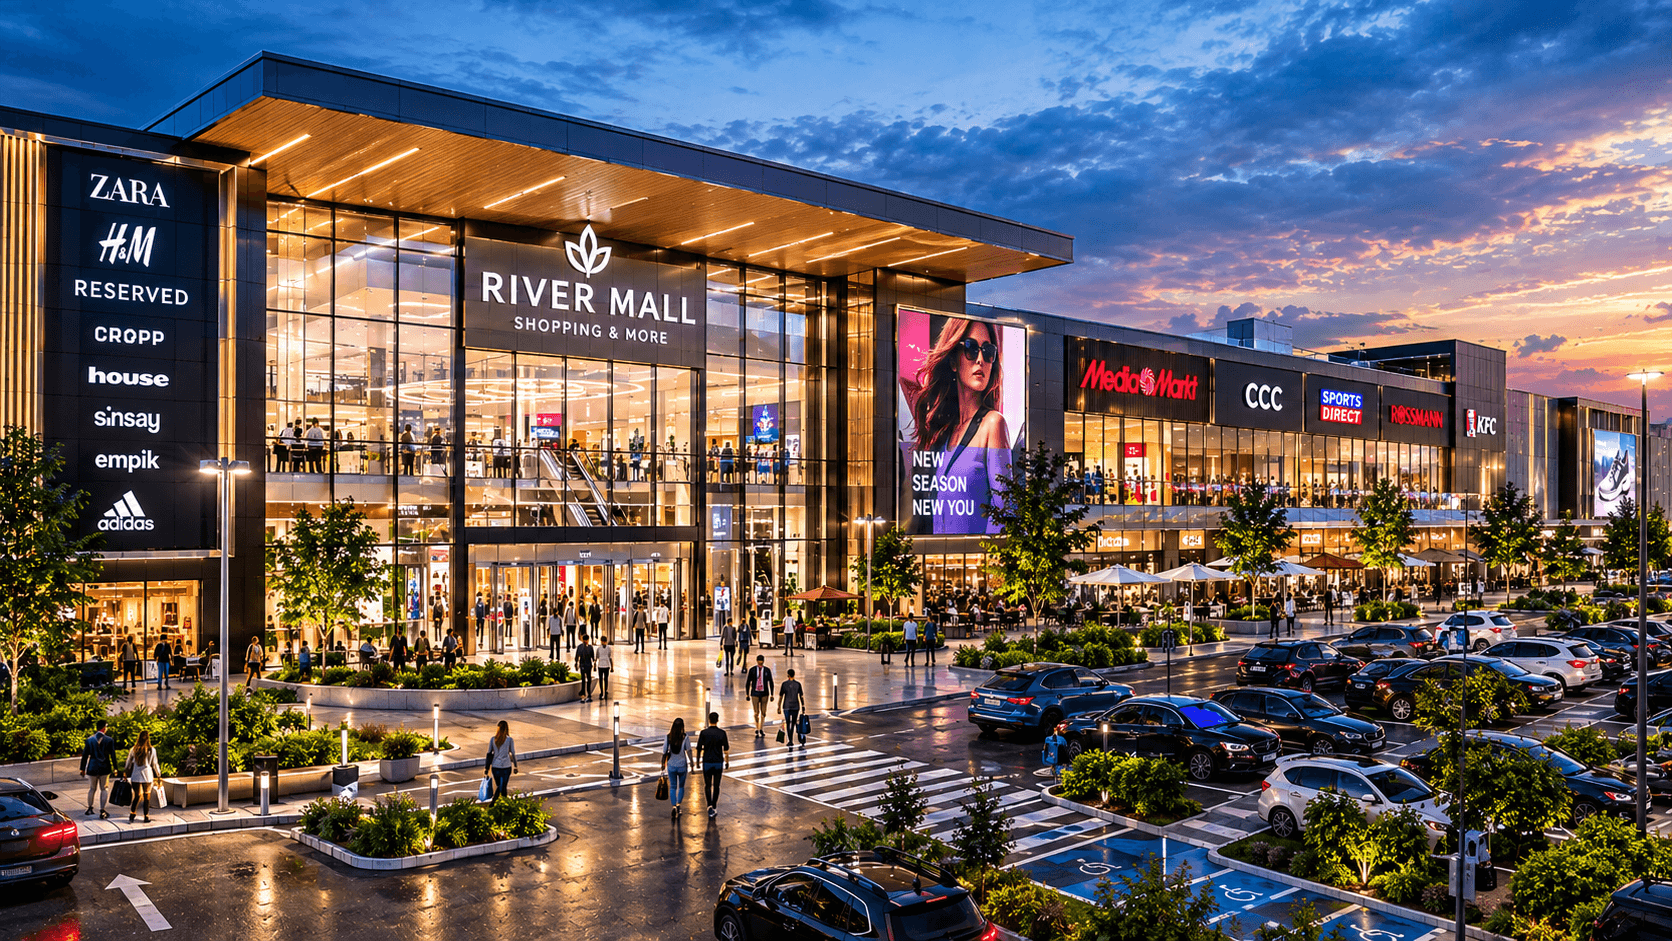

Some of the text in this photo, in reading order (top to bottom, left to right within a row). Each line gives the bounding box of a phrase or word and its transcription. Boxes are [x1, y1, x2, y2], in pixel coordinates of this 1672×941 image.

[89, 173, 170, 208] ZARA
[98, 222, 157, 268] H&M
[74, 279, 189, 306] RESERVED
[482, 271, 696, 325] RIVER MALL
[94, 326, 165, 346] CROPP
[514, 316, 669, 344] SHOPPING & MORE
[88, 366, 170, 388] house
[1245, 382, 1283, 412] CCC
[1322, 390, 1362, 408] SPORTS
[94, 405, 161, 434] sinsay
[1322, 406, 1361, 424] DIRECT
[1391, 405, 1444, 429] ROSSMANN
[1476, 415, 1497, 436] KFC
[94, 449, 160, 473] empik
[912, 450, 945, 468] NEW
[912, 474, 967, 493] SEASON
[912, 498, 975, 517] NEW YOU
[97, 512, 155, 531] adidas
